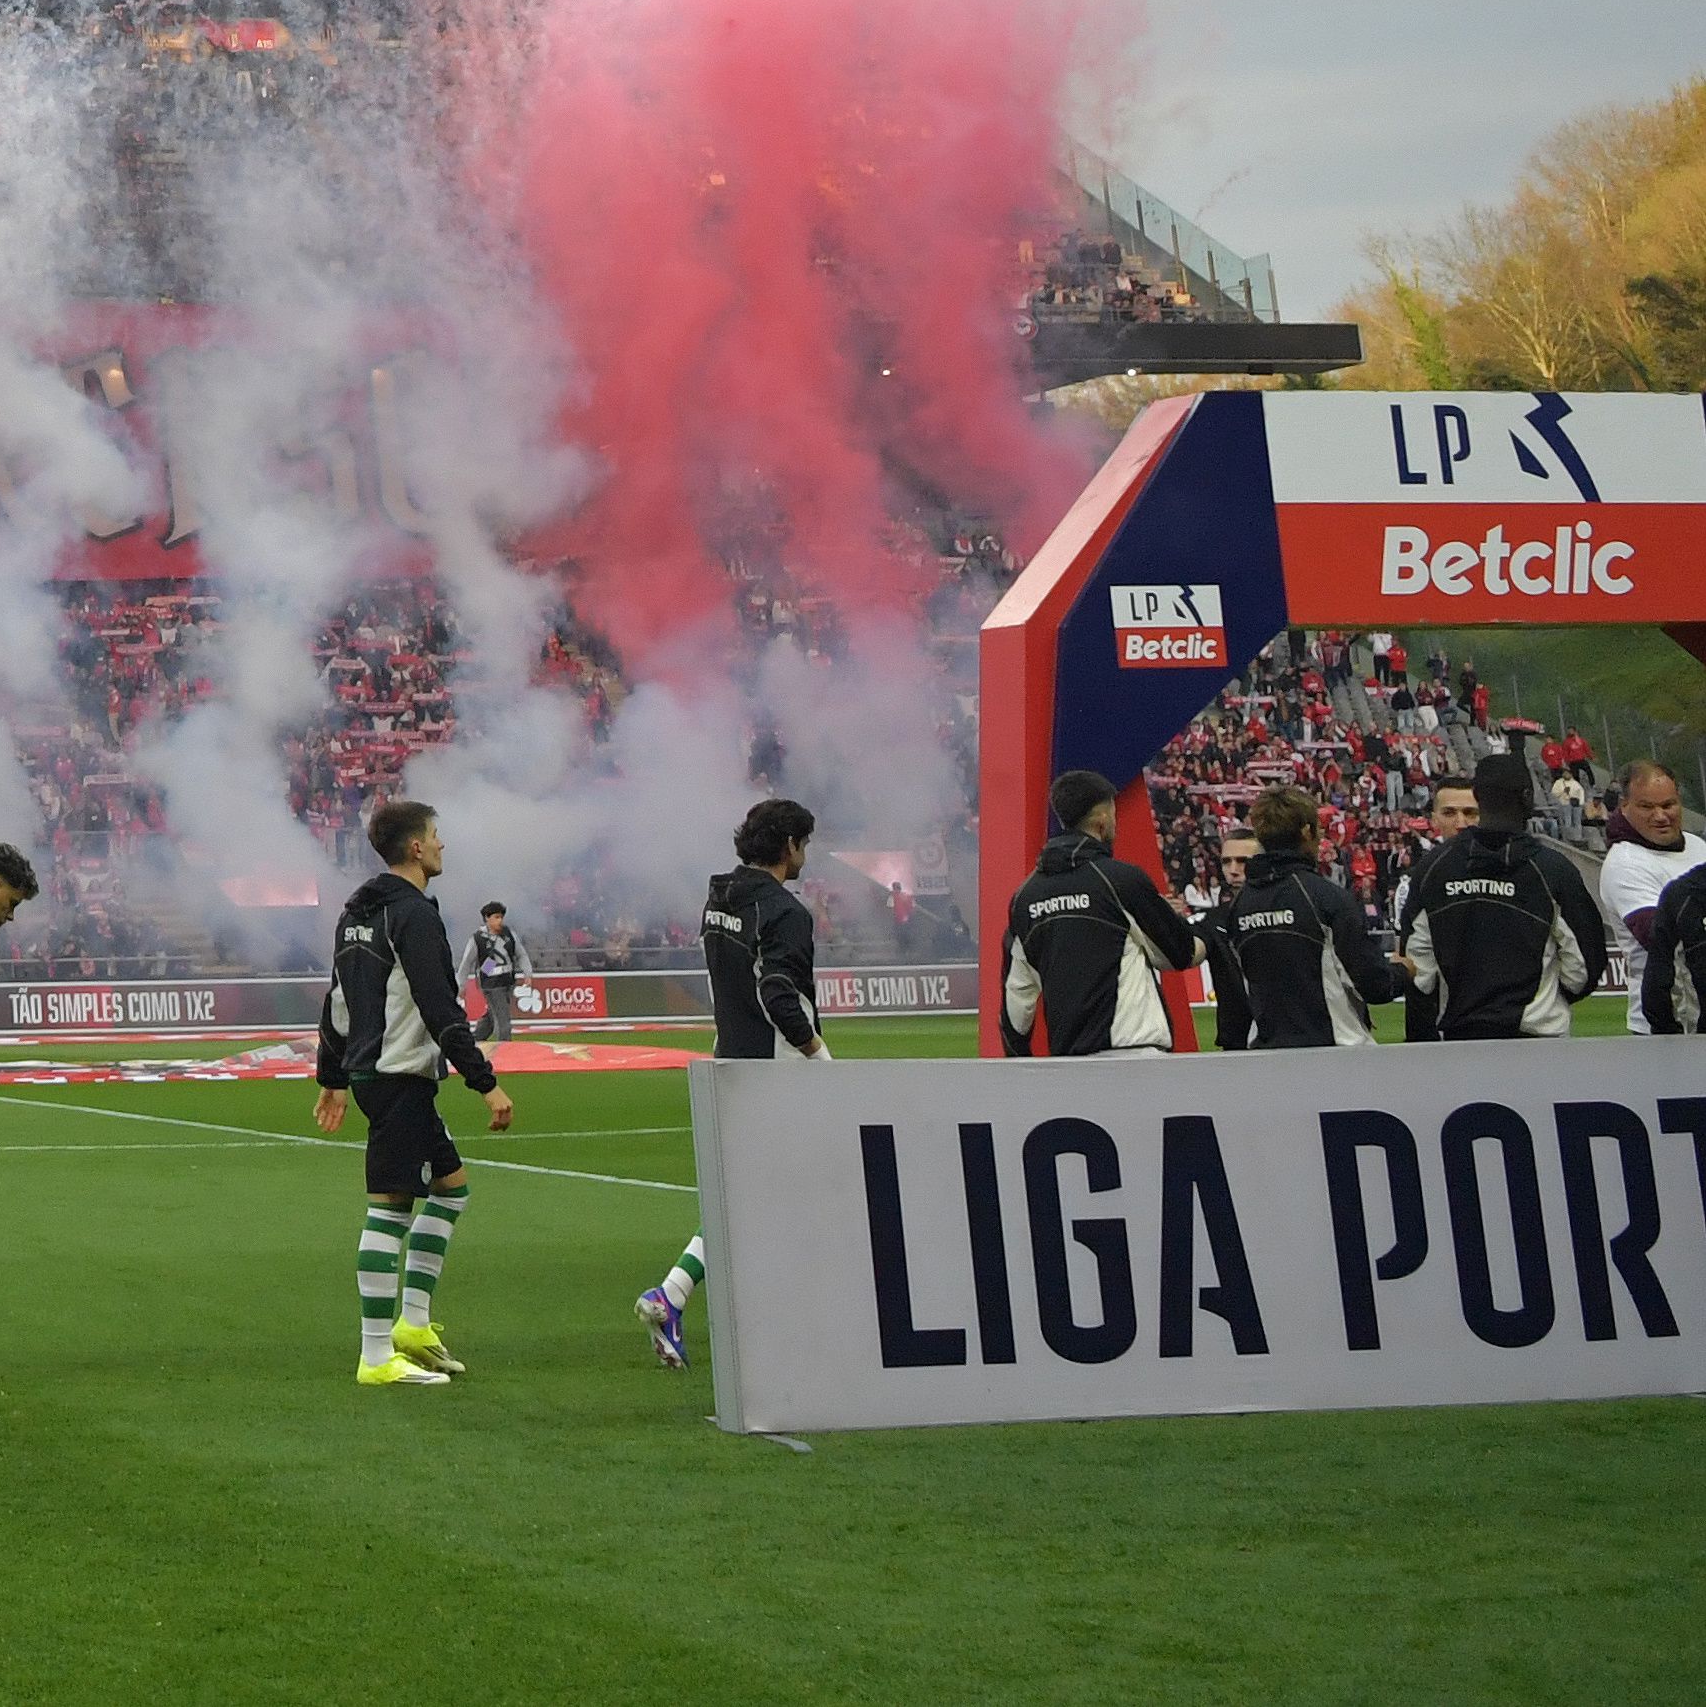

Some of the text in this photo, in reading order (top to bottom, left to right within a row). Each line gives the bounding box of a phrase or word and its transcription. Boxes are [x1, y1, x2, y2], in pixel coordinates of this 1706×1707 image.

[1389, 403, 1472, 485] LP
[1380, 520, 1635, 596] Betclic
[1128, 591, 1159, 622] LP
[1124, 631, 1218, 661] Betclic
[1445, 878, 1516, 898] SPORTING
[1028, 892, 1090, 920] SPORTING
[1237, 907, 1295, 930] SPORTING
[10, 987, 215, 1024] TÃO SIMPLES COMO 1X2
[545, 988, 595, 1009] JOGOS
[868, 976, 918, 1006] COMO
[920, 975, 951, 1005] 1X2
[859, 1115, 1270, 1369] LIGA
